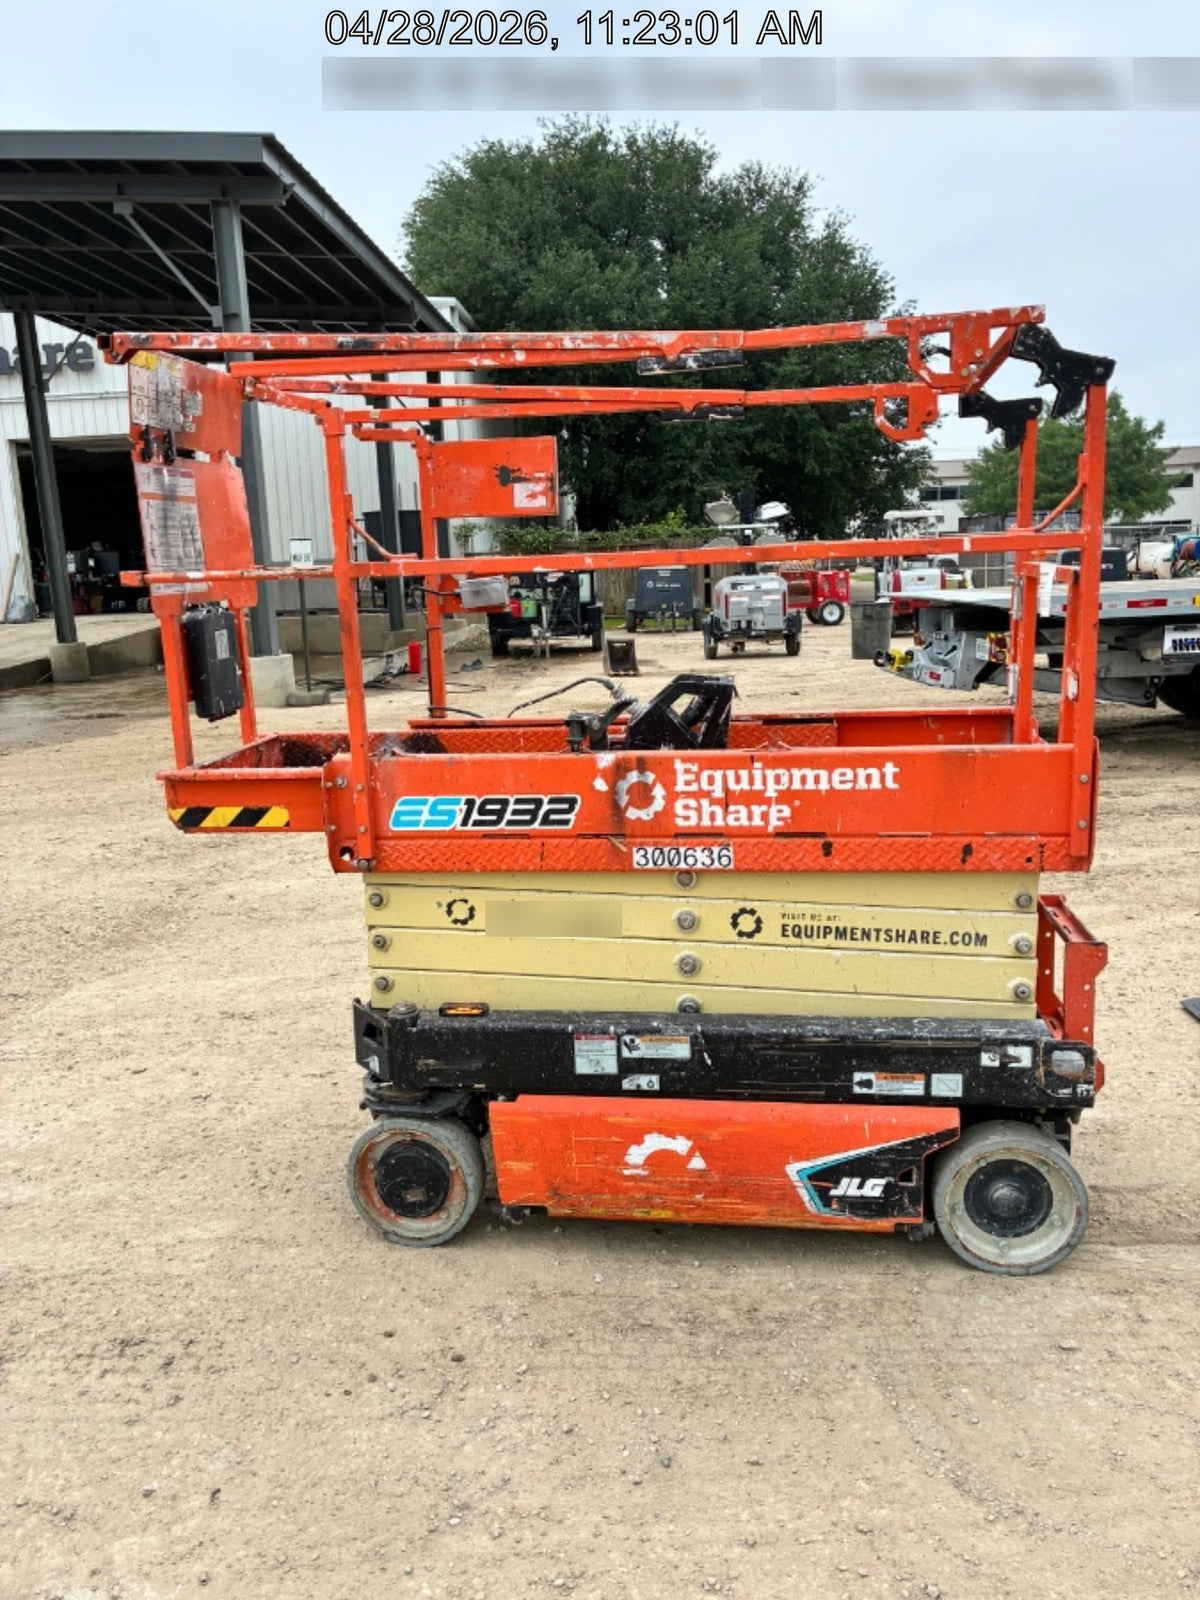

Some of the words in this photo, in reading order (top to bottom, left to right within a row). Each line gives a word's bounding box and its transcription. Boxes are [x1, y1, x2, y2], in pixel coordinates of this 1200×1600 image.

[674, 759, 900, 798] Equipment
[389, 796, 581, 830] ES1932
[636, 847, 732, 867] 300636
[781, 923, 988, 947] EQUIPMENTSHARE.COM
[829, 1177, 887, 1197] JLG
